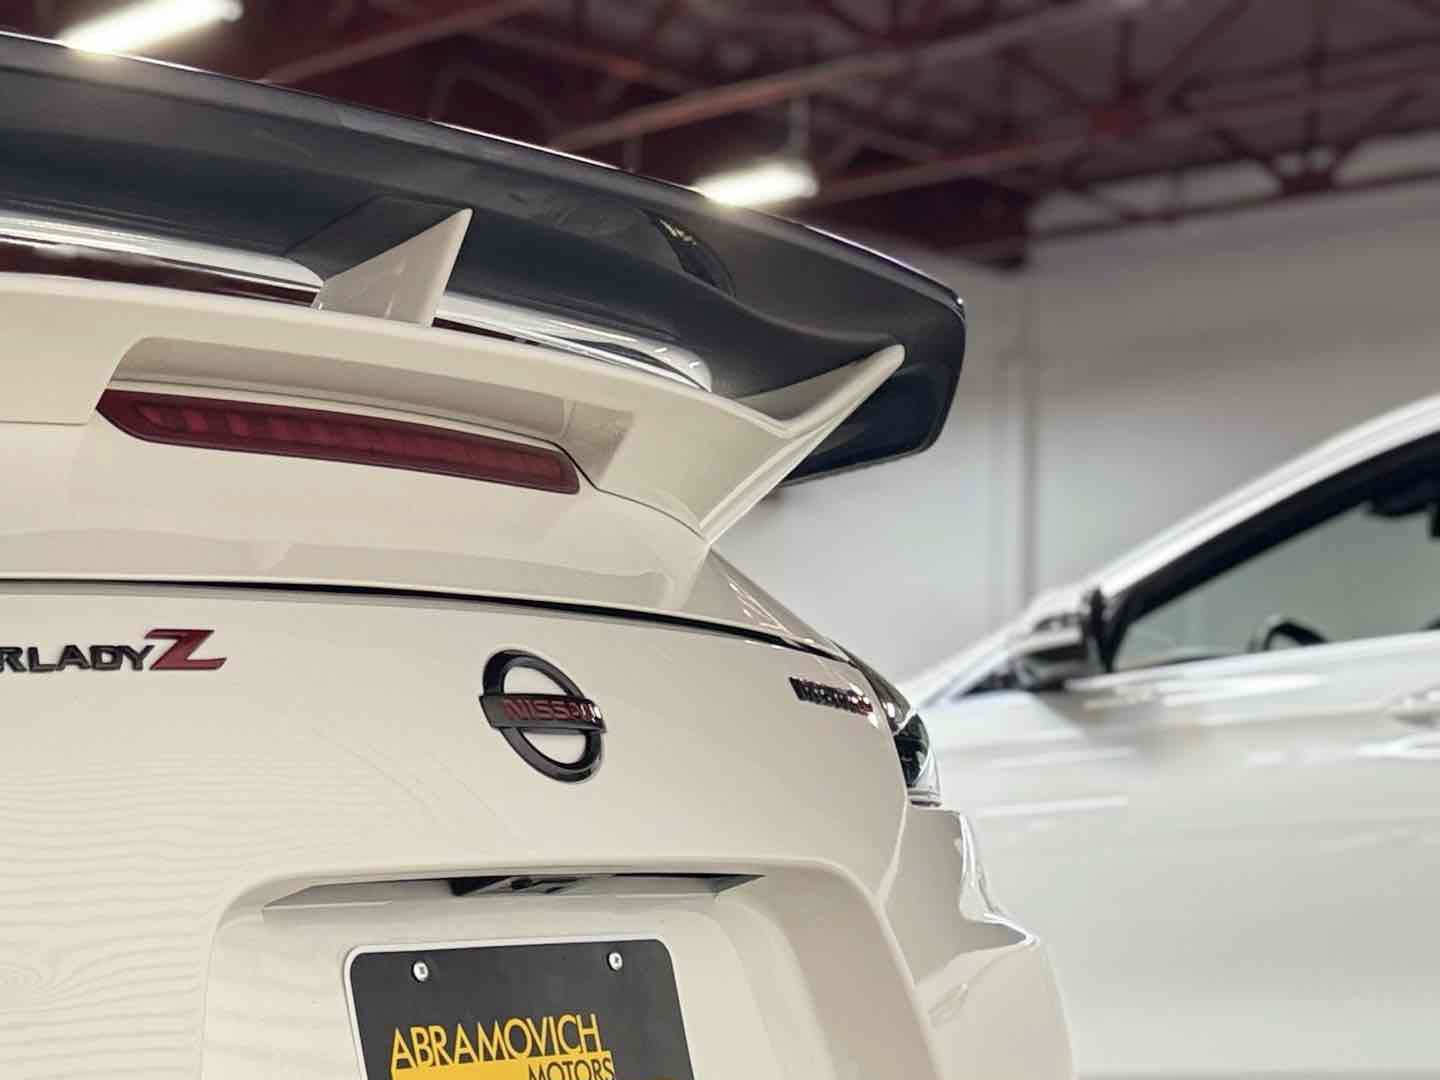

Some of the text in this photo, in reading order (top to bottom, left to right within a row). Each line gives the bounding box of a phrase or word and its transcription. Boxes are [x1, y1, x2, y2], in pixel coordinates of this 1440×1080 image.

[144, 628, 227, 670] Z
[502, 696, 602, 722] NISSAN
[392, 1013, 602, 1070] ABRAMOVICH
